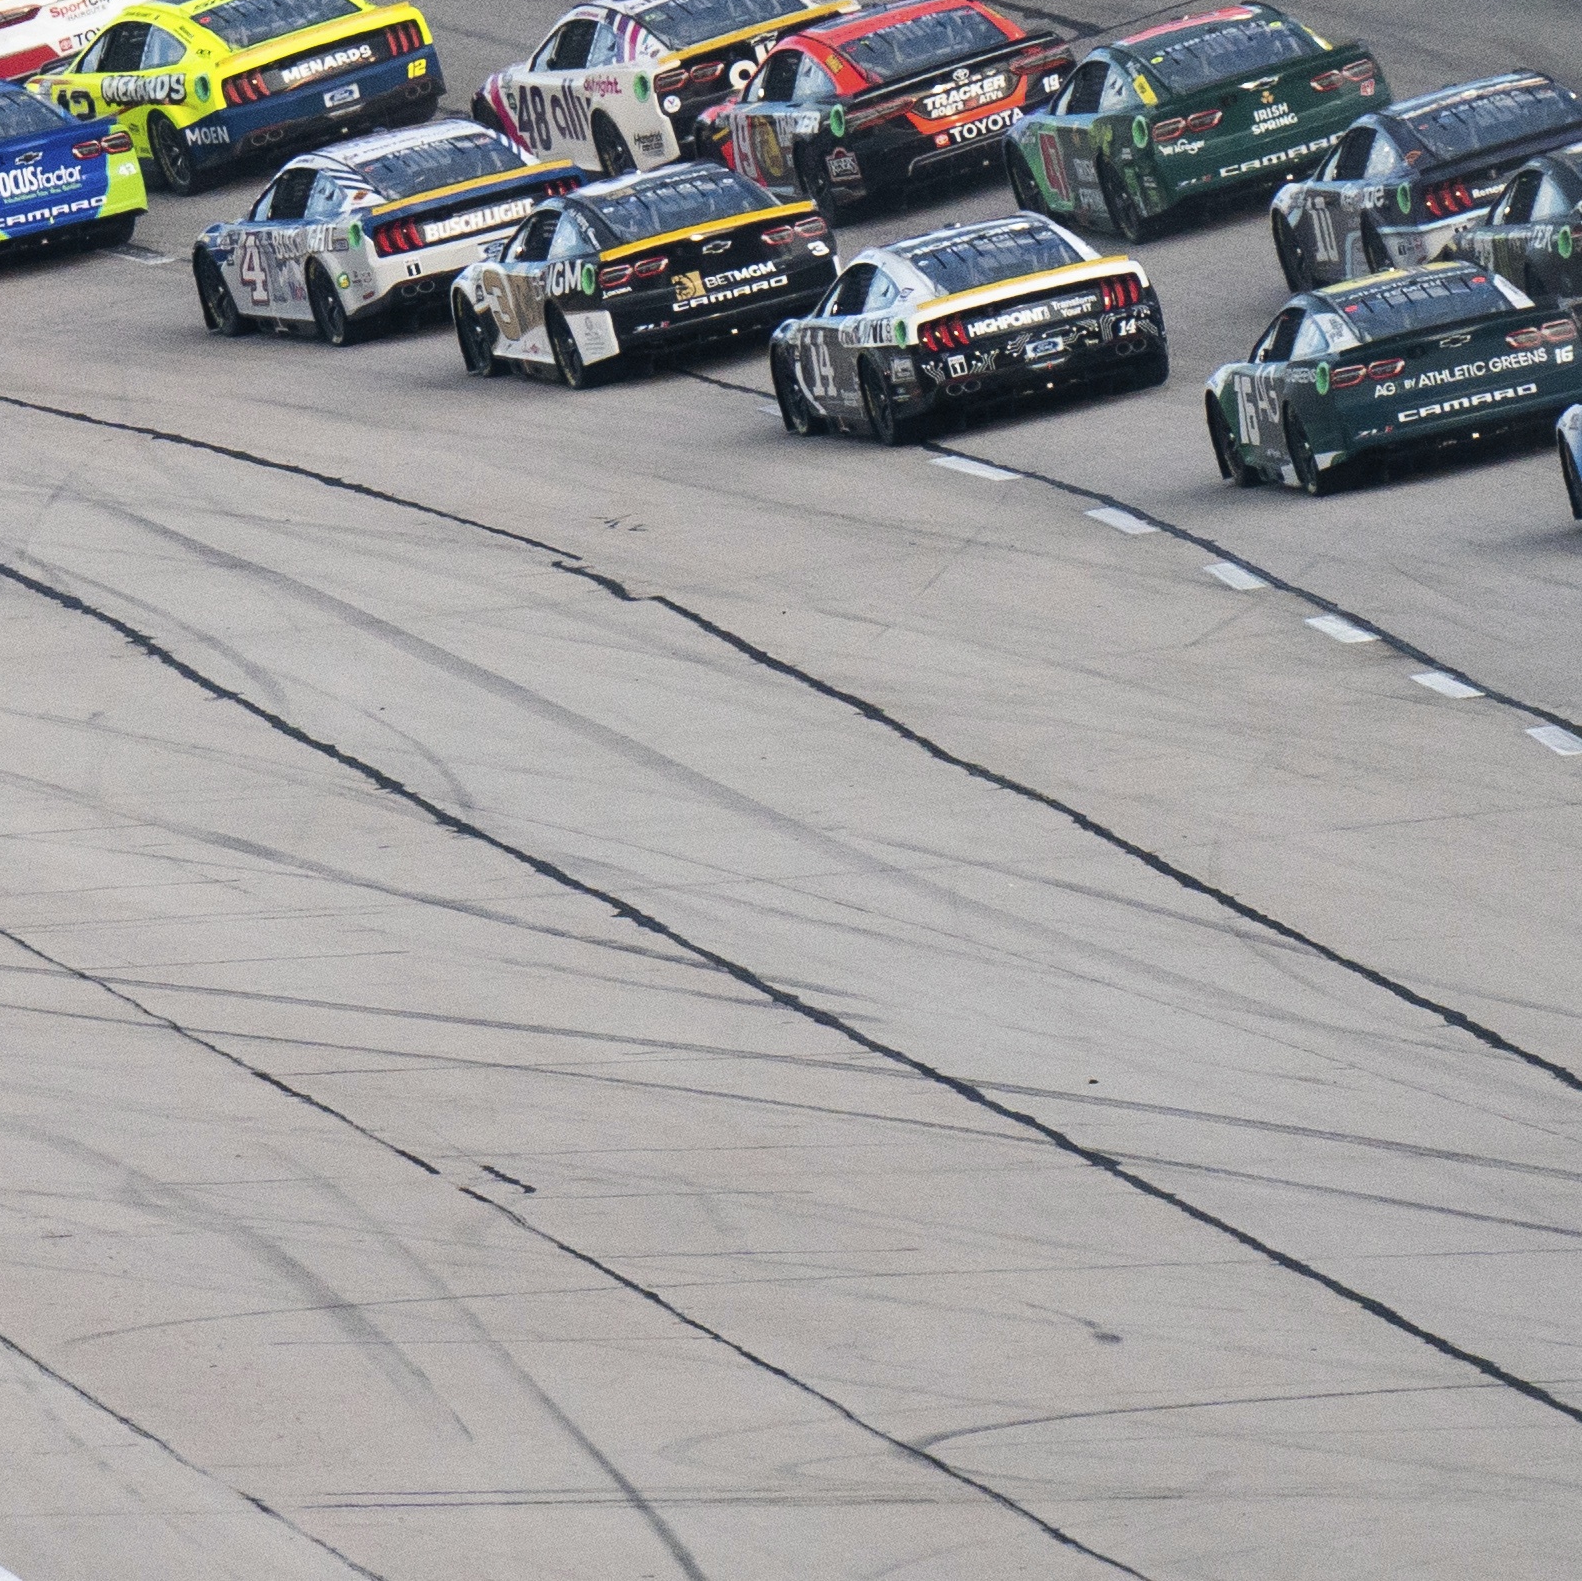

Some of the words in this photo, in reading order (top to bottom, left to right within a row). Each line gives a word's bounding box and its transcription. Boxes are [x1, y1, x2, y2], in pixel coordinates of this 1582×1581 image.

[281, 43, 373, 84] MENARDS
[406, 60, 427, 78] 12
[922, 73, 1007, 111] TRACKER
[517, 85, 553, 151] 48
[949, 107, 1024, 142] TOYOTA
[1251, 113, 1298, 136] SPRING
[1252, 102, 1289, 122] IRISH
[185, 126, 231, 147] MOEN
[806, 239, 830, 258] 3
[240, 230, 269, 306] 4
[704, 260, 776, 289] BETMGM
[672, 275, 788, 313] CAMARO
[1118, 318, 1137, 336] 14
[1554, 346, 1574, 366] 16
[1374, 381, 1396, 399] AG
[1404, 377, 1416, 389] BY
[1419, 361, 1486, 390] ATHLETIC
[1488, 348, 1548, 374] GREENS
[1397, 382, 1538, 423] CAMARO
